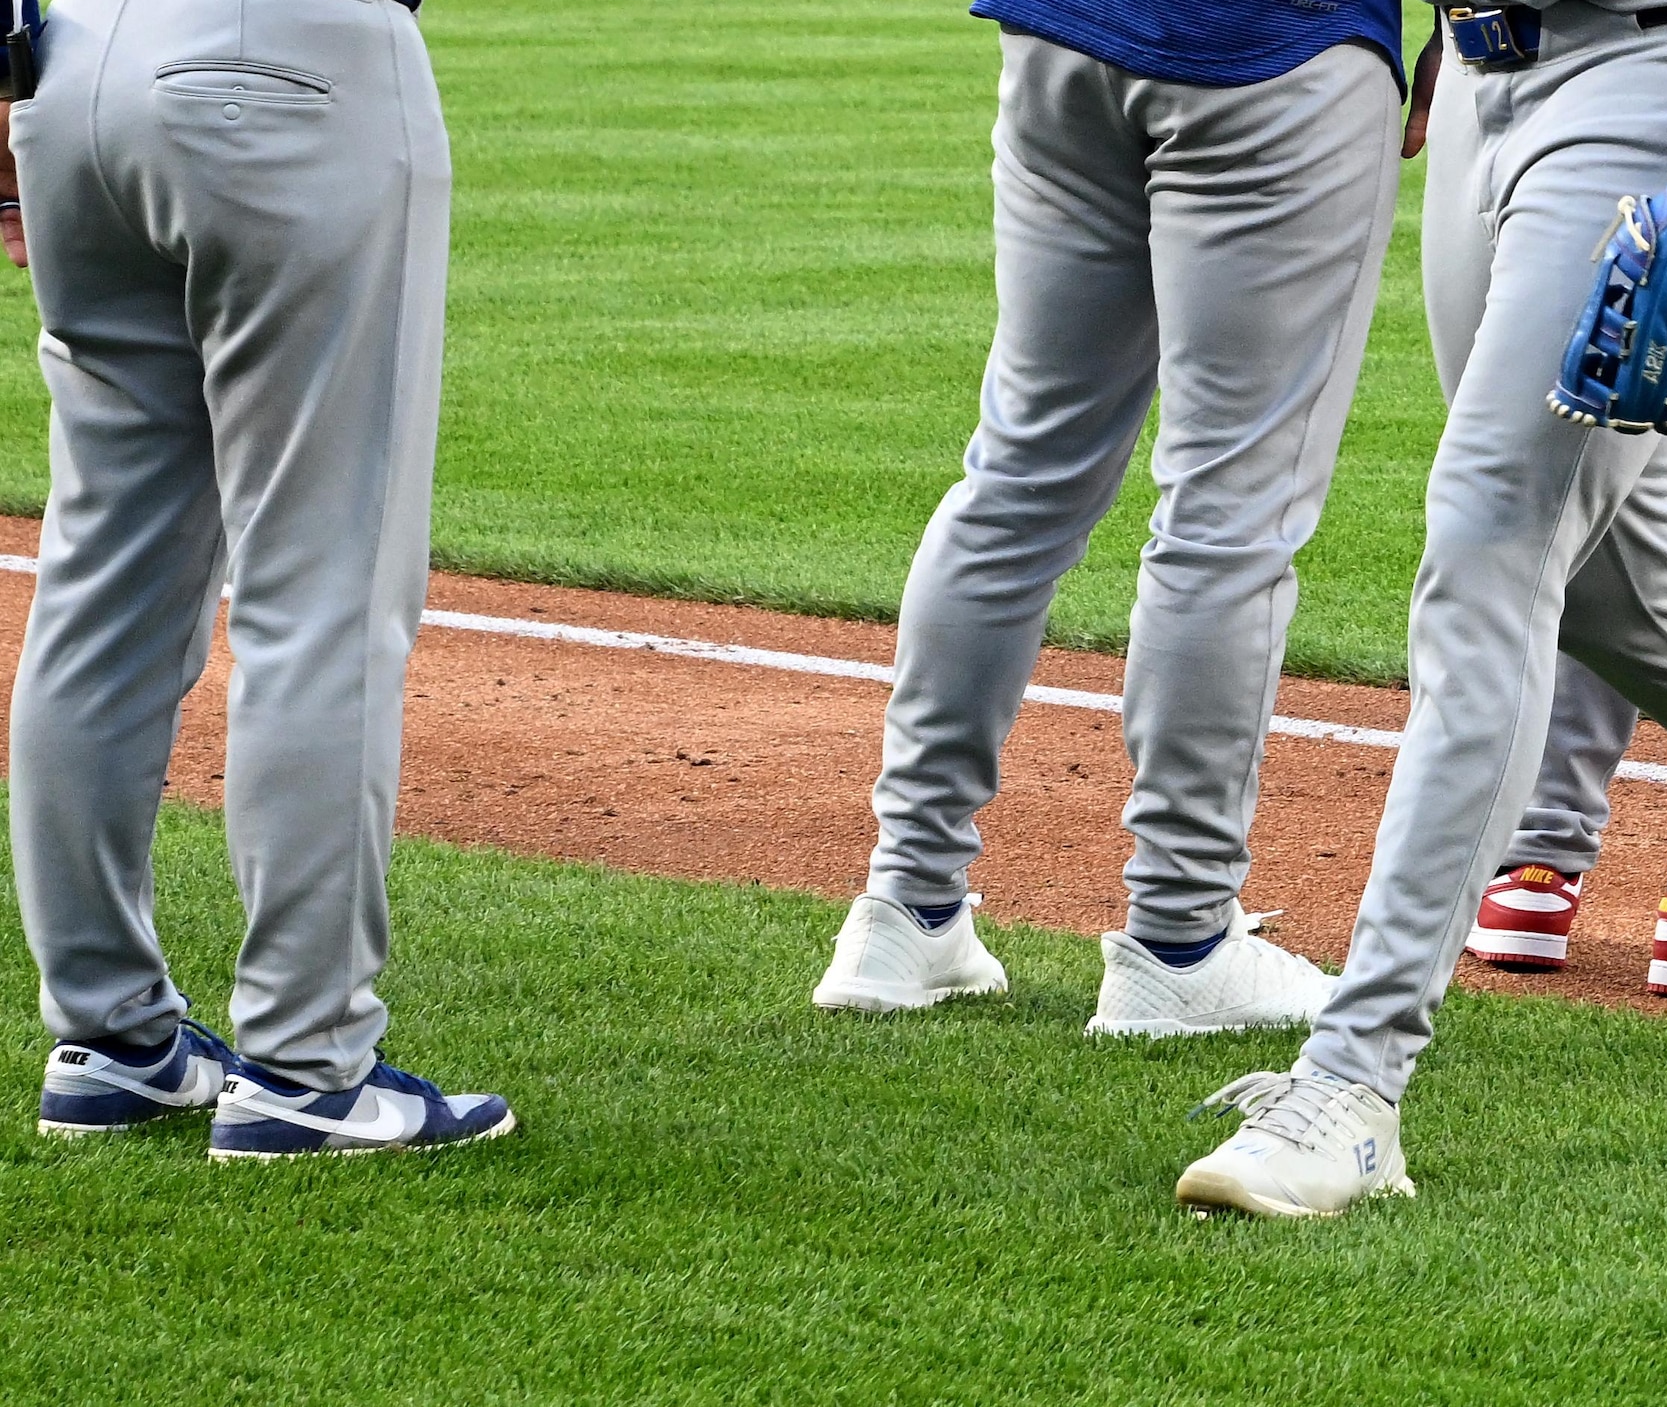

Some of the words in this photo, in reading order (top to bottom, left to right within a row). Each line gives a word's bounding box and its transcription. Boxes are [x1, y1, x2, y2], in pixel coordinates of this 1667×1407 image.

[1480, 20, 1508, 53] 12
[1520, 865, 1555, 885] NIKE
[57, 1049, 91, 1066] NIKE
[1353, 1137, 1377, 1178] 12
